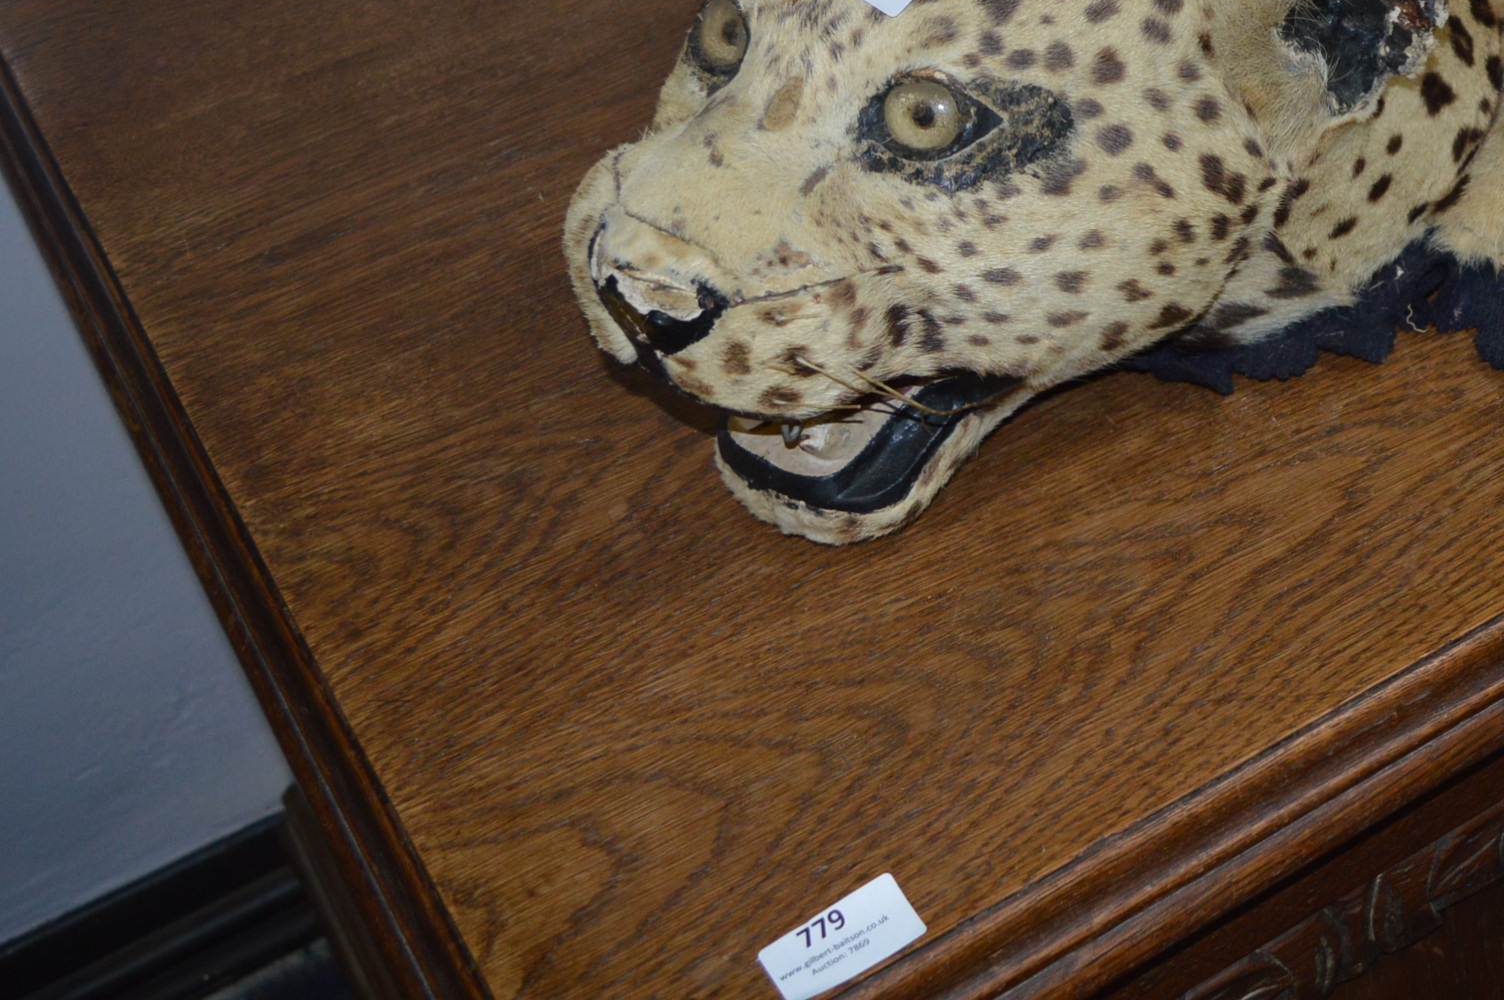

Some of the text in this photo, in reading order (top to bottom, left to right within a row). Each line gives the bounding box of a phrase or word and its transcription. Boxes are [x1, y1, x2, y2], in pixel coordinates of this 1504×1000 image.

[779, 914, 890, 982] www.gilbert-baitson.co.uk
[796, 909, 846, 948] 779
[811, 938, 870, 976] Auction: 7869
